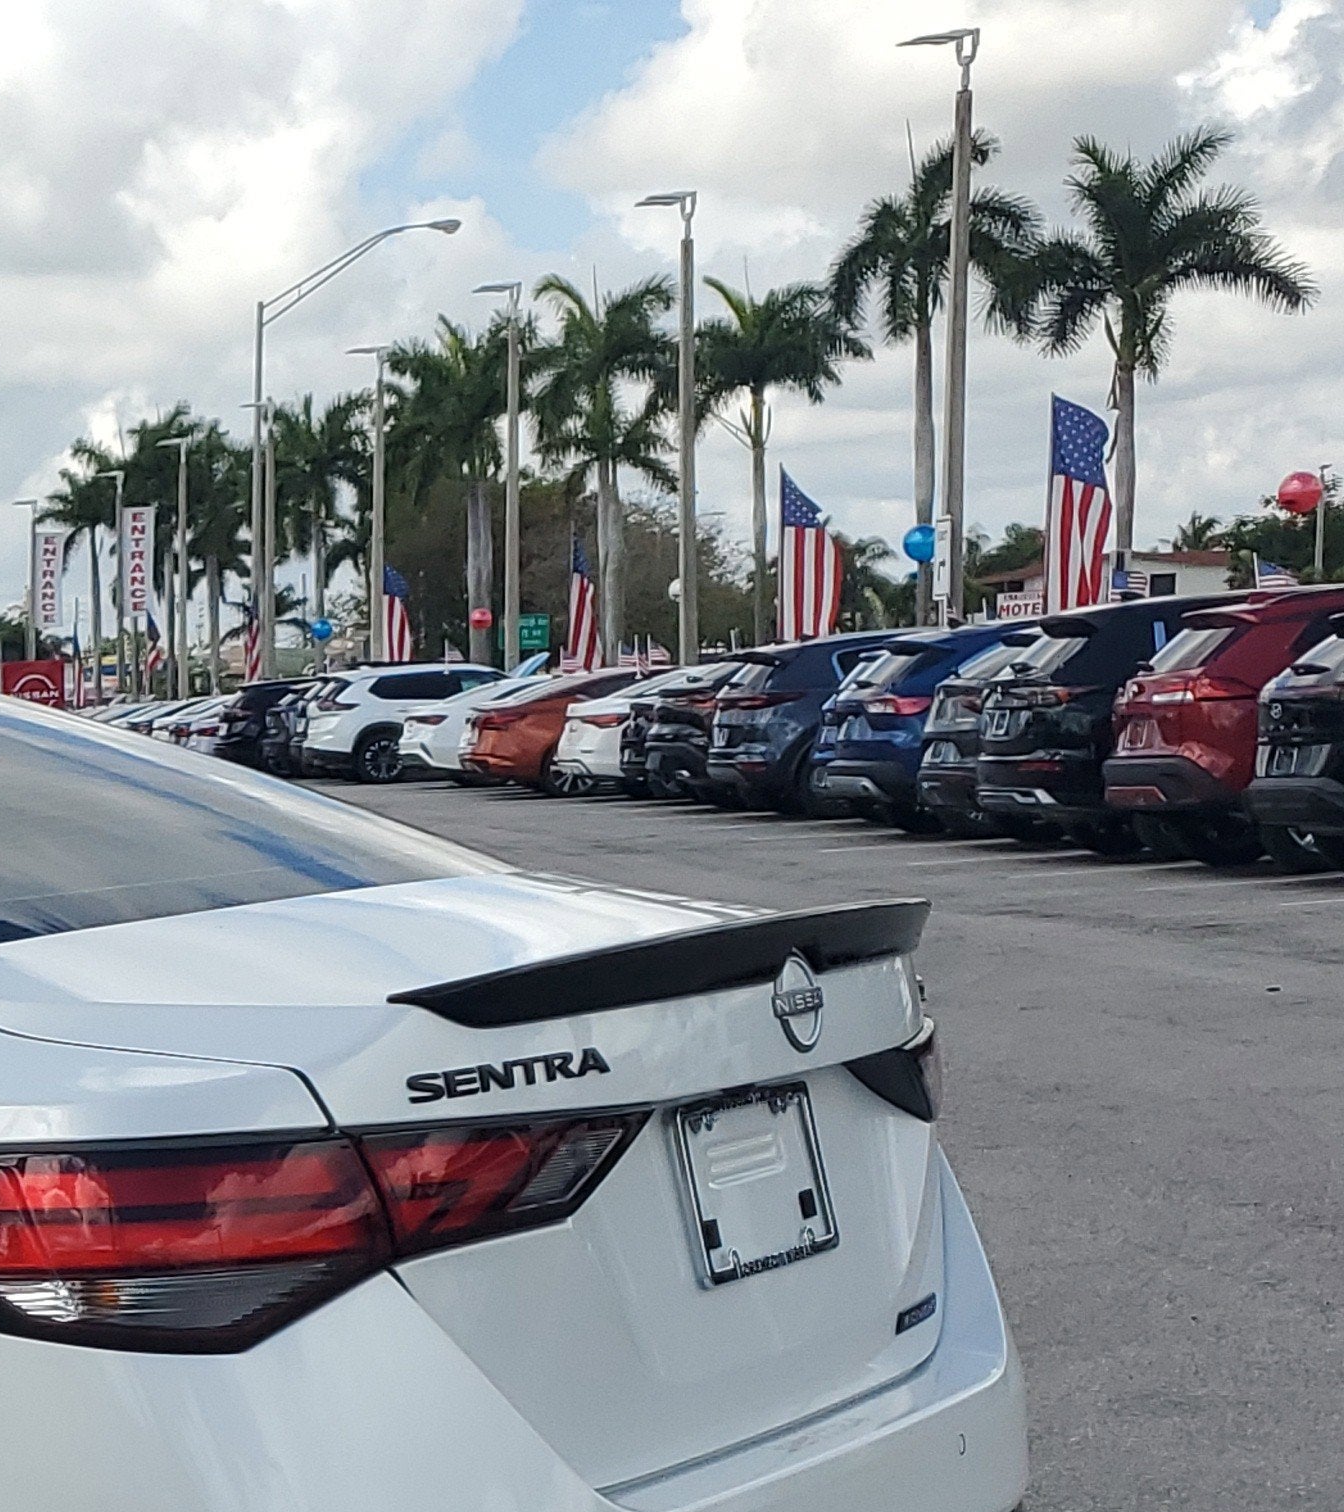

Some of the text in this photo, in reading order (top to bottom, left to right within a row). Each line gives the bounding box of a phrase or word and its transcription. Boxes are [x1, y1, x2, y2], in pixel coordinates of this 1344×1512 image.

[41, 535, 57, 624] ENTRANCE
[130, 511, 147, 613] ENTRANCE
[997, 602, 1042, 619] MOTE
[406, 1047, 611, 1104] SENTRA
